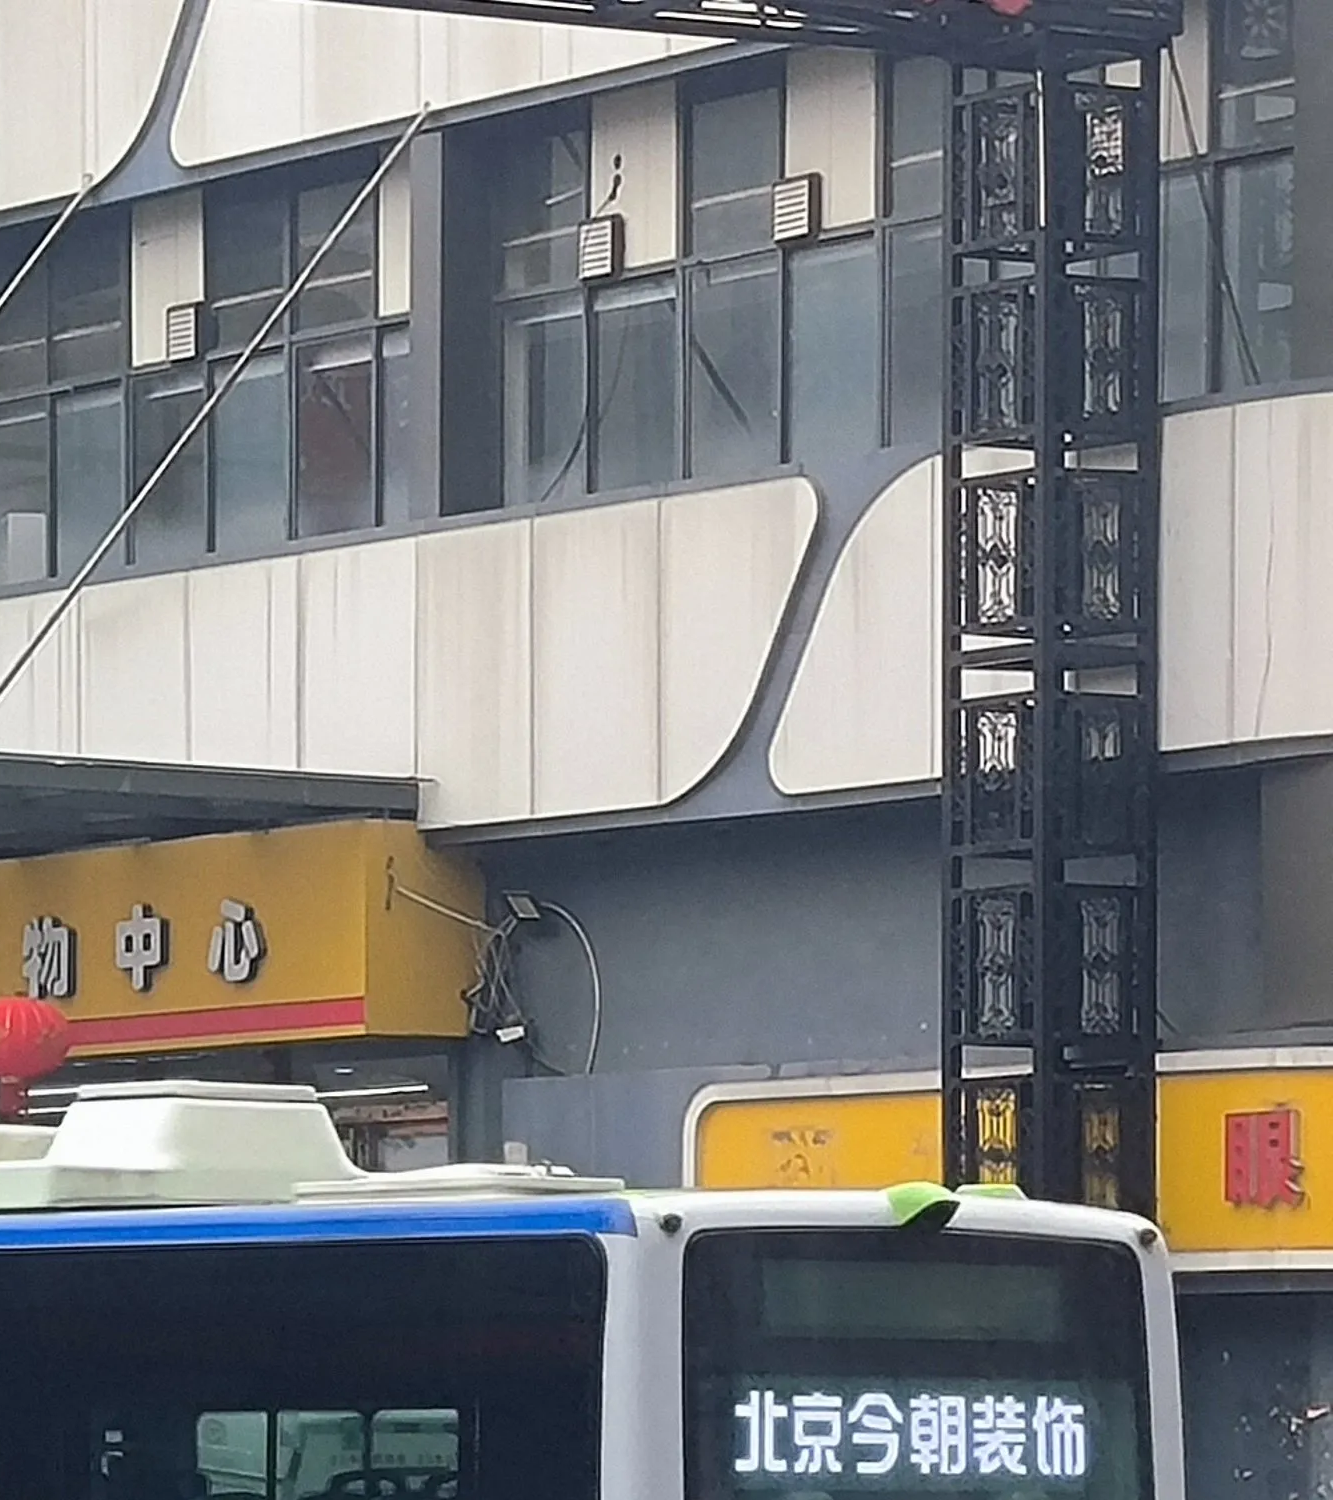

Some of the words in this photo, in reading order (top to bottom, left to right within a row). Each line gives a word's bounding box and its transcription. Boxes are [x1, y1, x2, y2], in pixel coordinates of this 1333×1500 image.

[733, 1389, 1089, 1477] 北京今朝装饰
